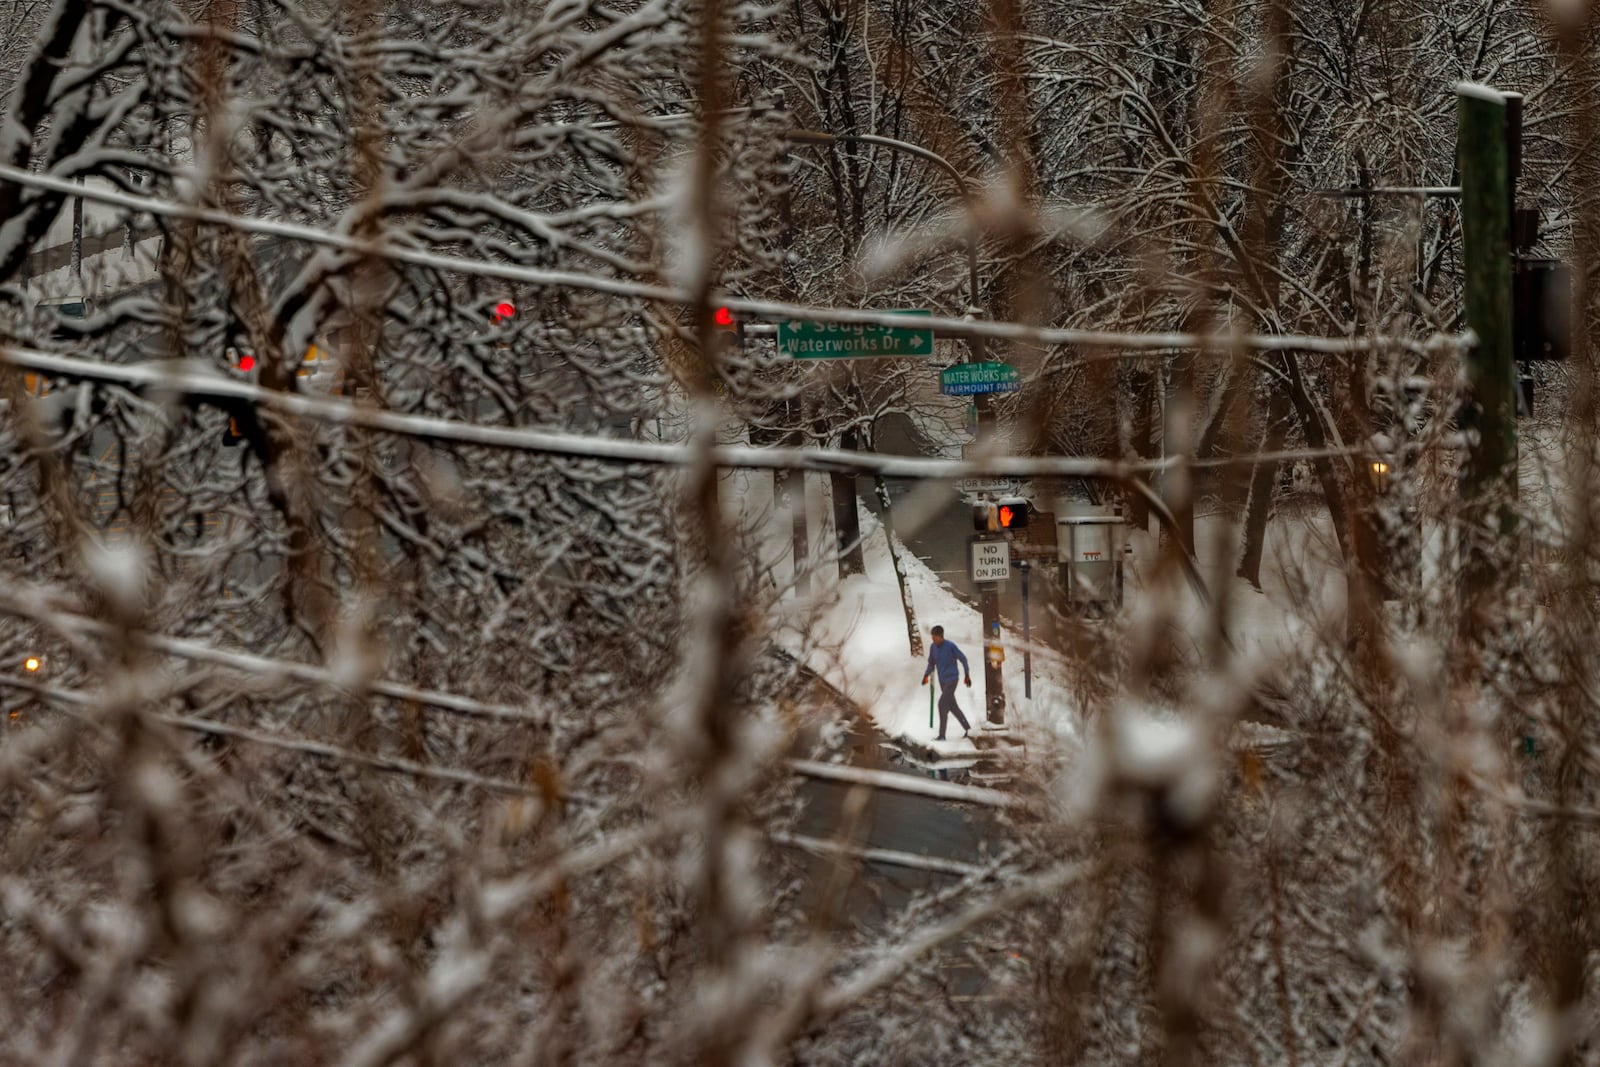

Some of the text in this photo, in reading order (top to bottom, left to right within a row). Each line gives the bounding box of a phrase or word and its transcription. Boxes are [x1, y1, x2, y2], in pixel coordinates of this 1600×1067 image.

[787, 335, 901, 353] Waterworks Dr
[943, 372, 970, 384] WATER
[971, 370, 1000, 383] WORKS
[944, 381, 1019, 395] FAIRMOUNT PARK
[965, 479, 978, 487] OR
[983, 545, 998, 554] NO
[979, 556, 1004, 566] TURN
[975, 567, 1008, 578] ON RED
